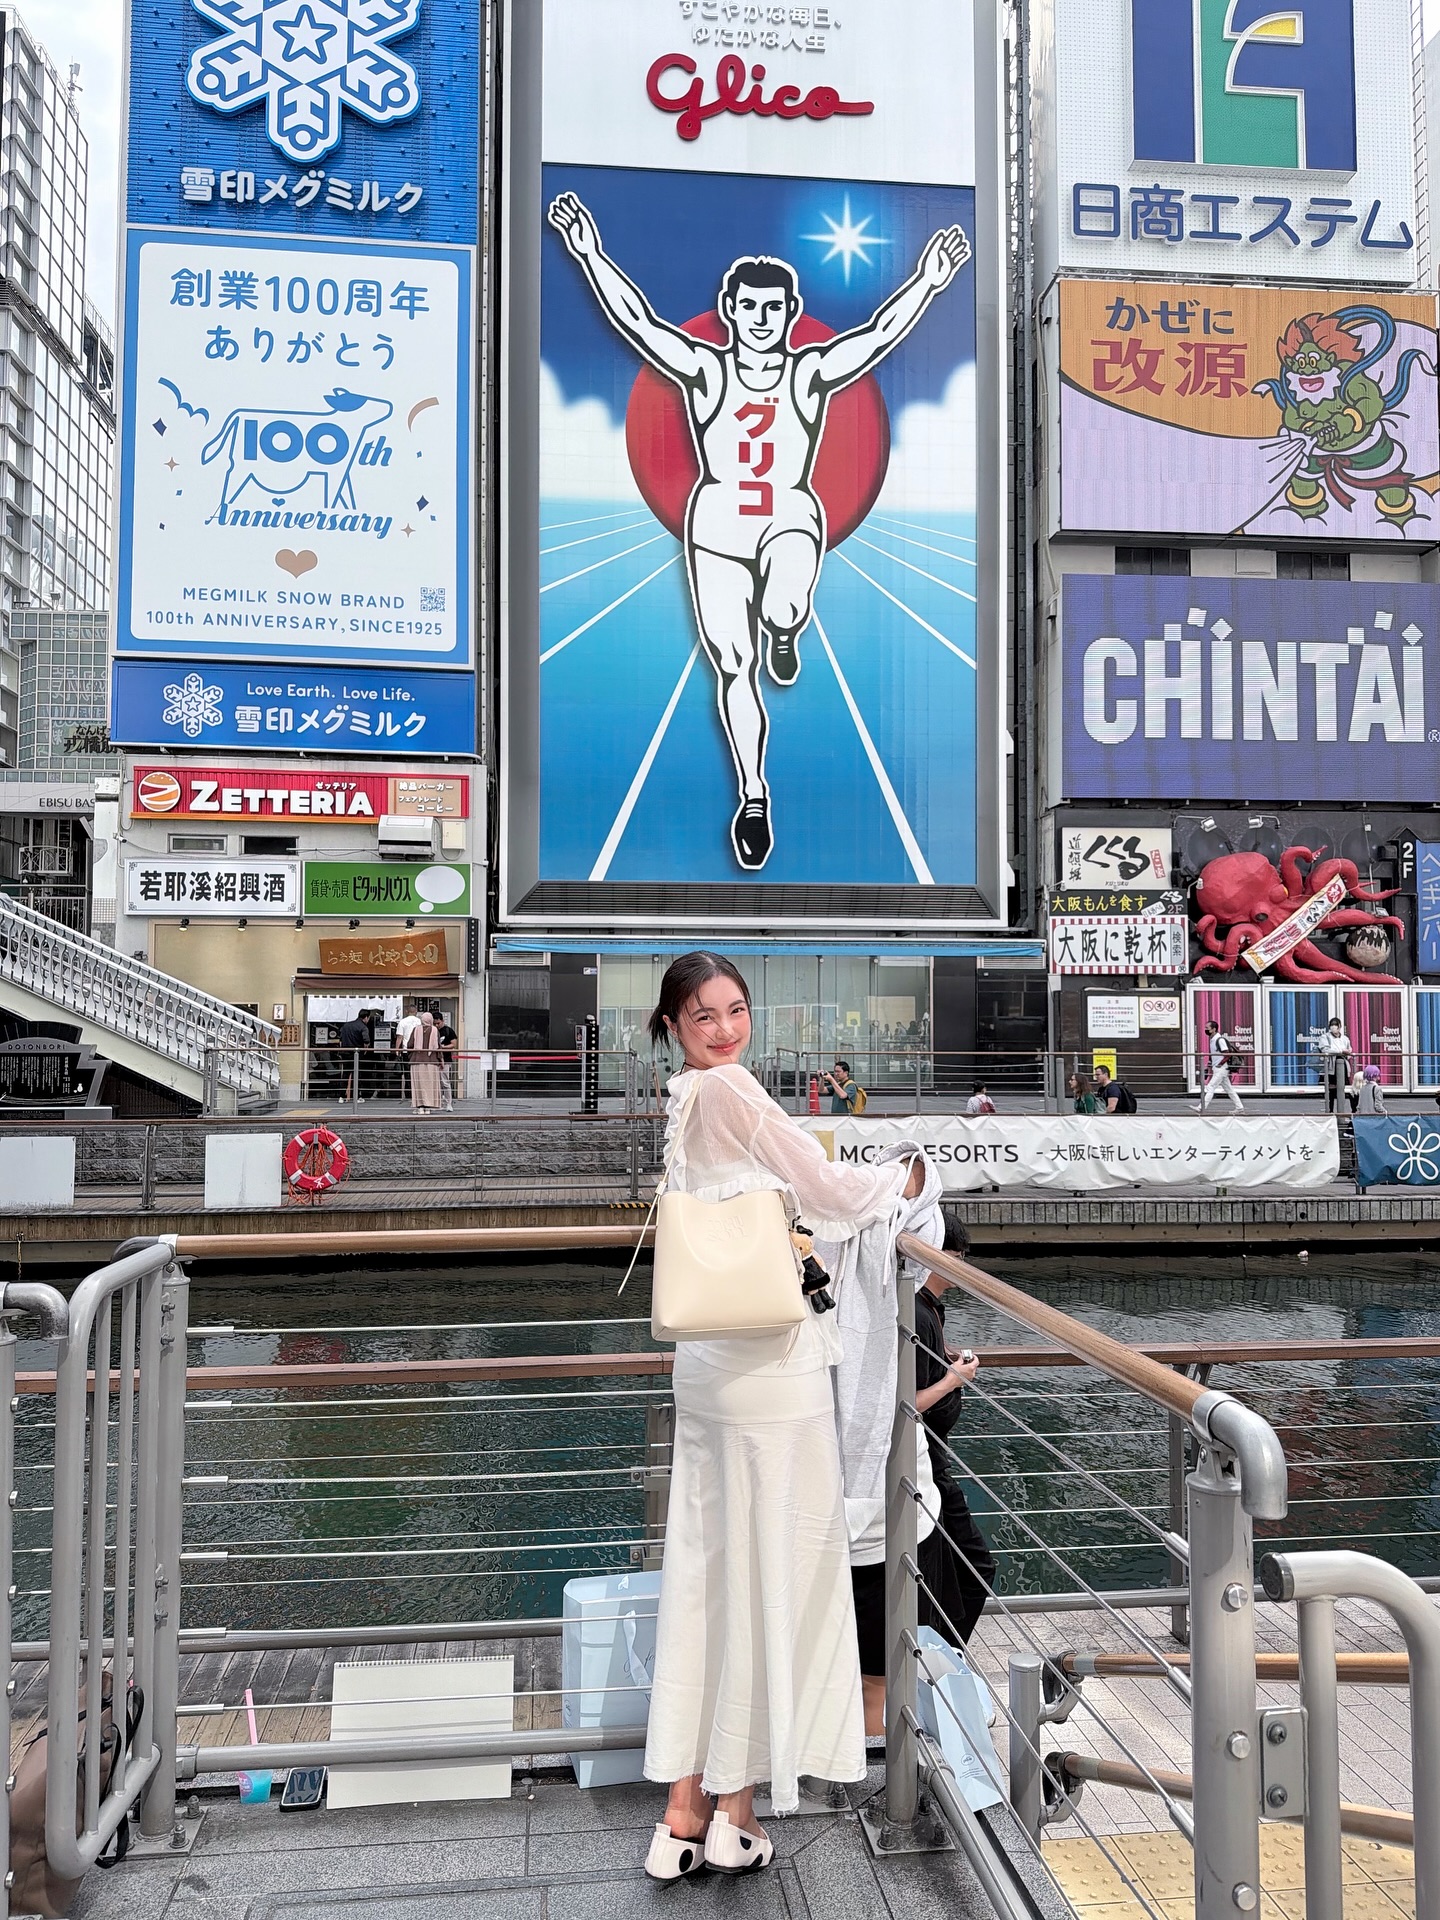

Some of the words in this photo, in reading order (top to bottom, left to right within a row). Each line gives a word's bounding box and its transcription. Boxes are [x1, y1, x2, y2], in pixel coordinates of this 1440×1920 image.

[679, 0, 841, 29] すこやかな毎日、
[692, 24, 825, 53] ゆたかな人生
[180, 167, 424, 213] 雪印メグミルク
[1073, 183, 1413, 249] 日商エステム
[170, 268, 430, 320] 創業100周年
[1105, 297, 1234, 335] かぜに
[205, 325, 395, 370] ありがとう
[1090, 337, 1248, 398] 改源
[733, 397, 779, 516] グリコ
[205, 503, 393, 539] Anniversary
[183, 587, 268, 603] MEGMILK
[277, 591, 332, 605] SNOW
[341, 594, 405, 609] BRAND
[147, 610, 194, 625] 100th
[247, 682, 282, 696] Love
[287, 684, 335, 698] Earth.
[343, 686, 379, 700] Love
[382, 688, 416, 701] Life.
[235, 704, 426, 738] 雪印メグミルク
[189, 780, 374, 816] ZETTERIA
[315, 782, 356, 790] ゼッテリア
[400, 782, 454, 791] 絶品バーガー
[39, 797, 73, 807] EBISU
[417, 804, 454, 812] コーヒー
[310, 879, 350, 899] 賃貸・売買
[353, 875, 412, 901] ピタットハウス
[1052, 894, 1147, 912] 大阪もんを食す
[1168, 904, 1184, 914] 2F
[1058, 926, 1167, 964] 大阪に乾杯
[840, 1145, 883, 1163] MG
[923, 1144, 1018, 1163] ESORTS
